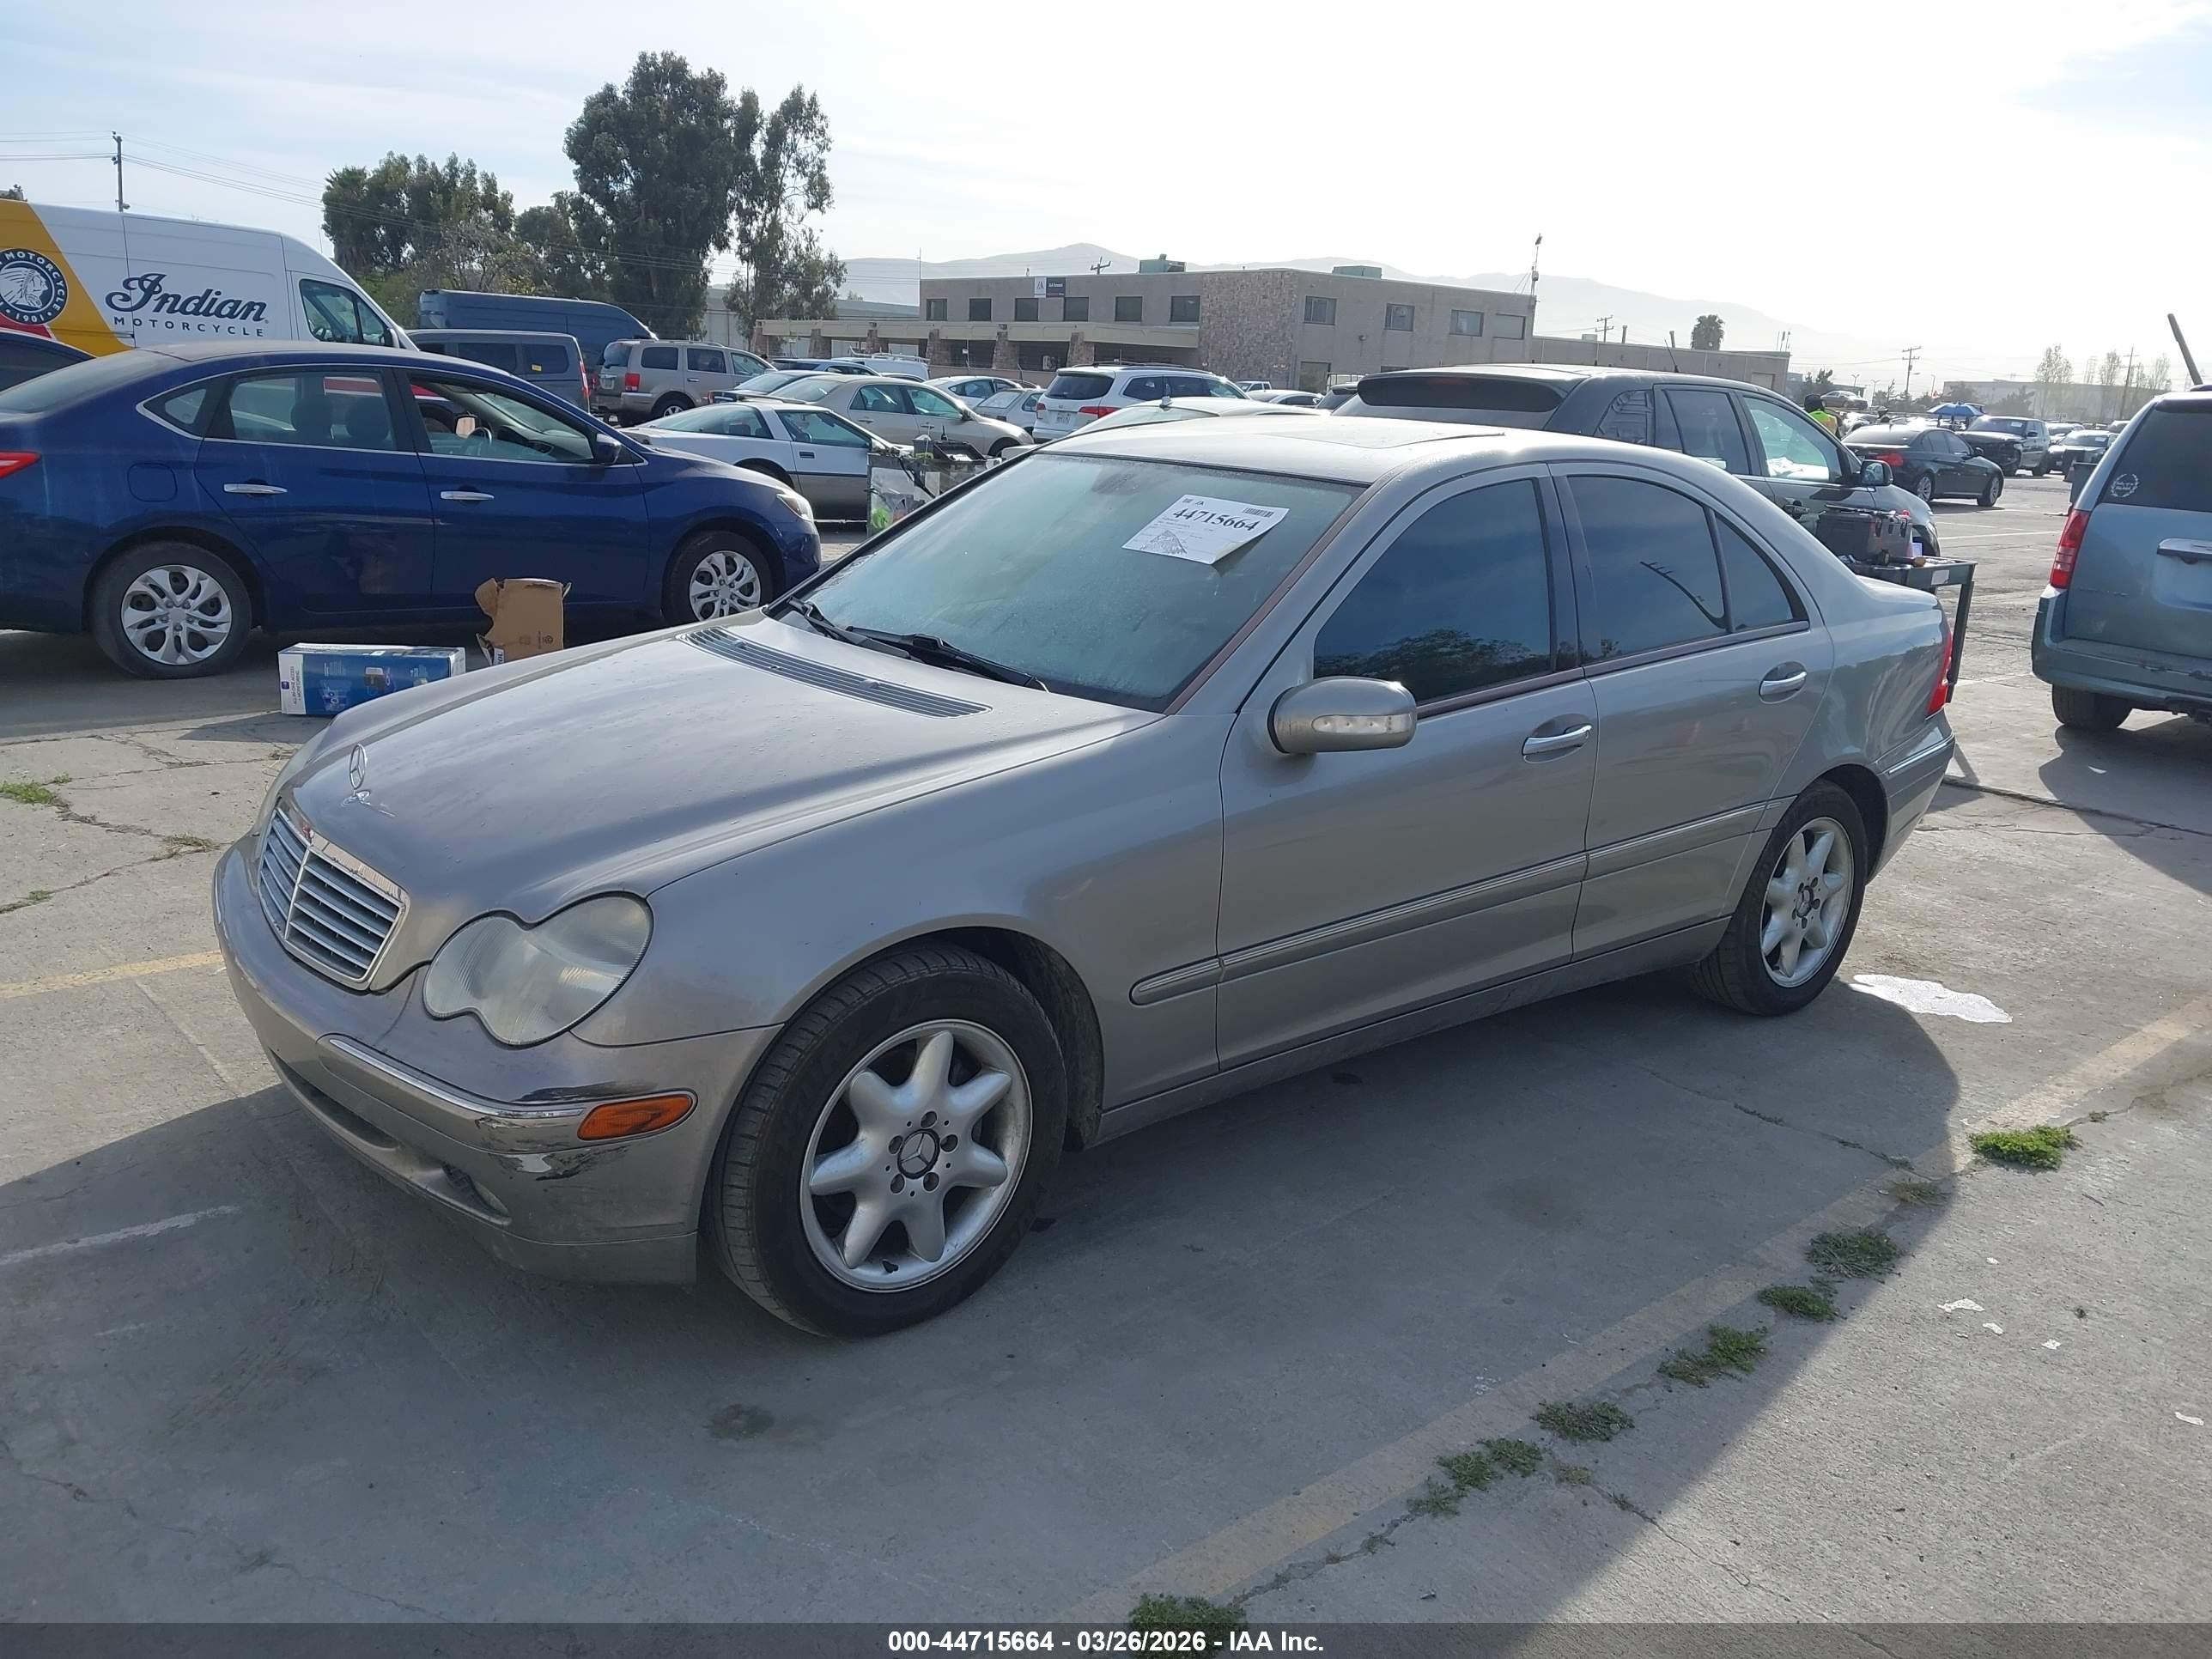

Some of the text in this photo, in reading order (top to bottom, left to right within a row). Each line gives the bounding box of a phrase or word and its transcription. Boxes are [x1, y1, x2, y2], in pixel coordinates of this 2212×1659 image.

[4, 252, 65, 311] MOTORCYCLE
[105, 273, 267, 322] Indian
[15, 313, 45, 323] 1901
[113, 316, 264, 337] MOTORCYCLE
[1173, 507, 1261, 532] 44715664
